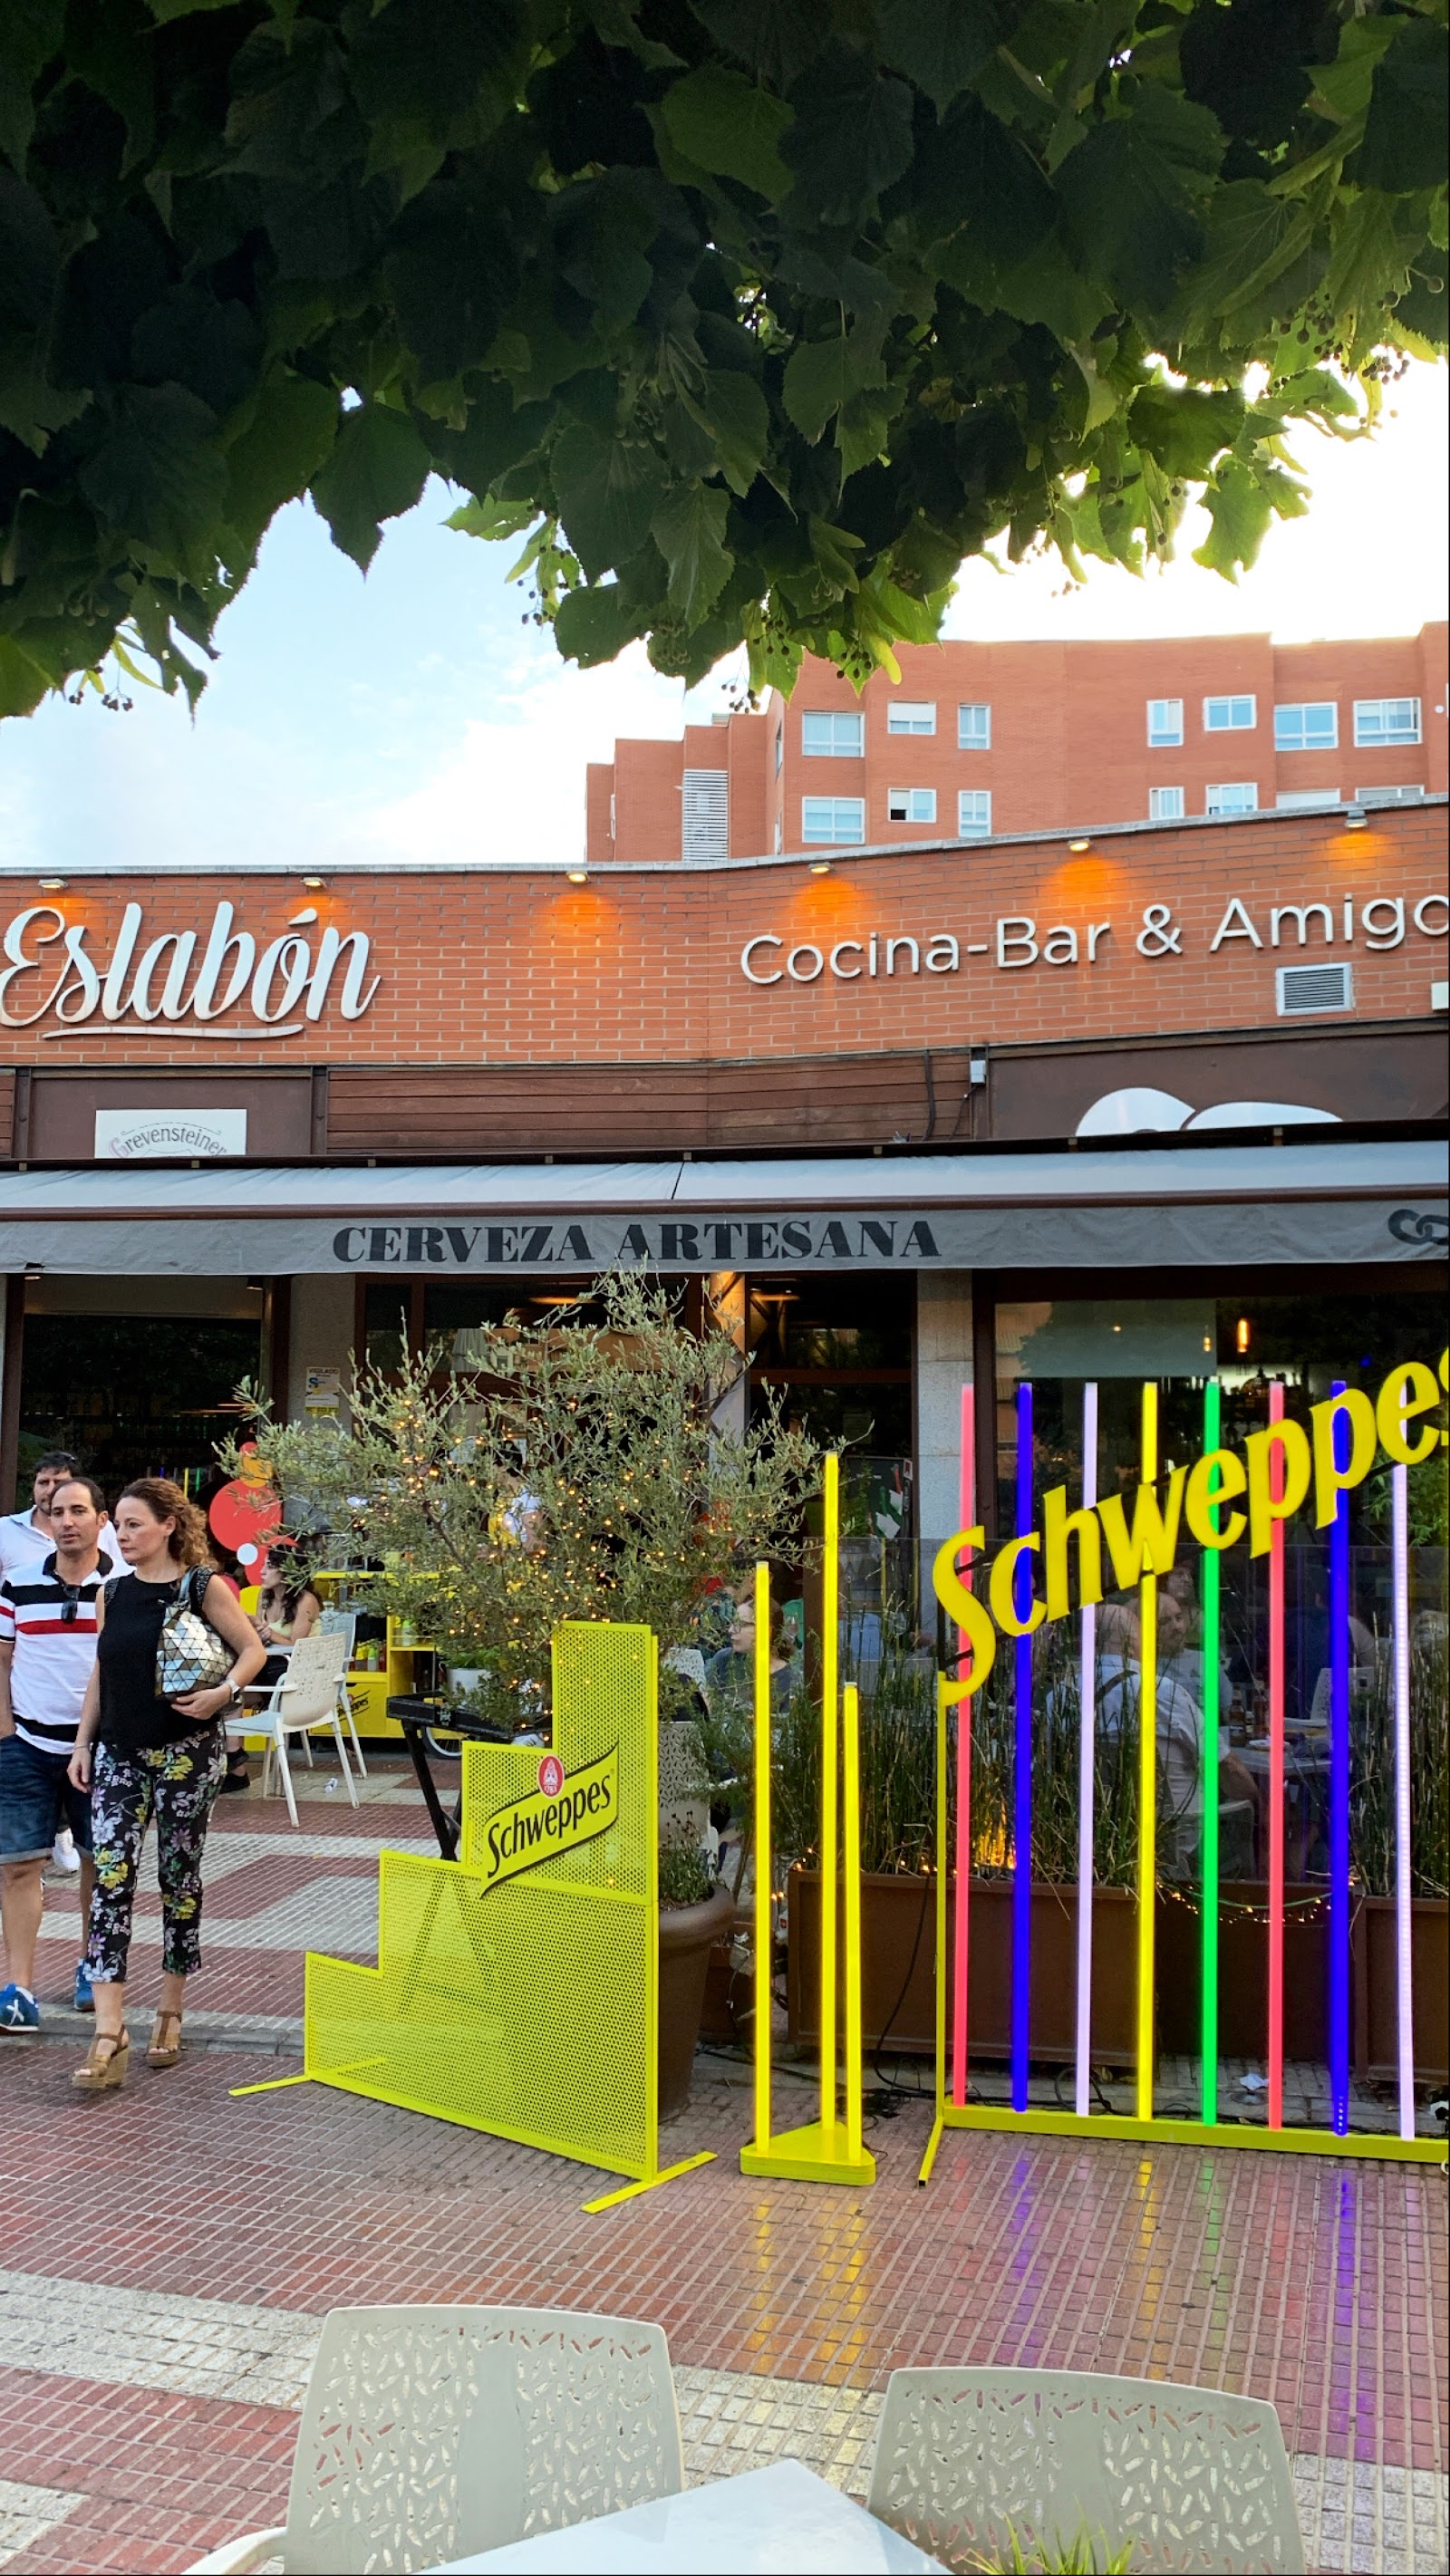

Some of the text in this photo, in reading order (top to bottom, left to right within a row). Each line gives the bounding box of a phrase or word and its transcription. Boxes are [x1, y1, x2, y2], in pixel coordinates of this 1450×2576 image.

[0, 901, 382, 1028] Eslabón
[740, 917, 1110, 984] Cocina-Bar
[1136, 903, 1183, 957] &
[108, 1126, 227, 1158] Grevensteiner
[332, 1220, 943, 1263] CERVEZA ARTESANA
[932, 1345, 1449, 1708] Schweppe
[488, 1775, 611, 1878] Schweppes
